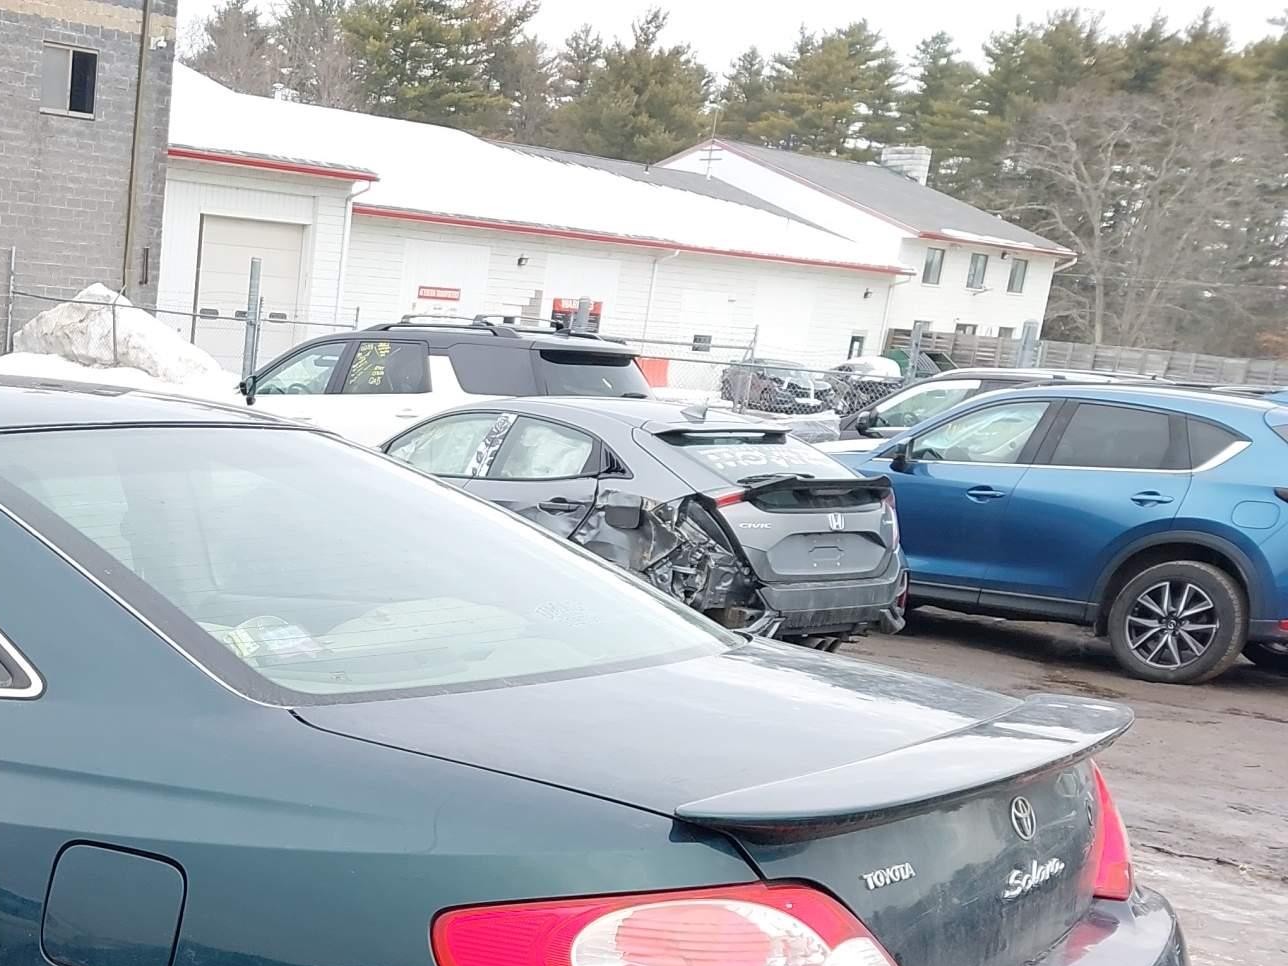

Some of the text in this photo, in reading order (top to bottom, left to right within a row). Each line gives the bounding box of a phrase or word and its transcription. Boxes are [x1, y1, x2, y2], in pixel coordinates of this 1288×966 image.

[738, 521, 773, 529] CIVIC
[862, 862, 916, 890] TOYOTA
[1003, 857, 1066, 899] Solara
